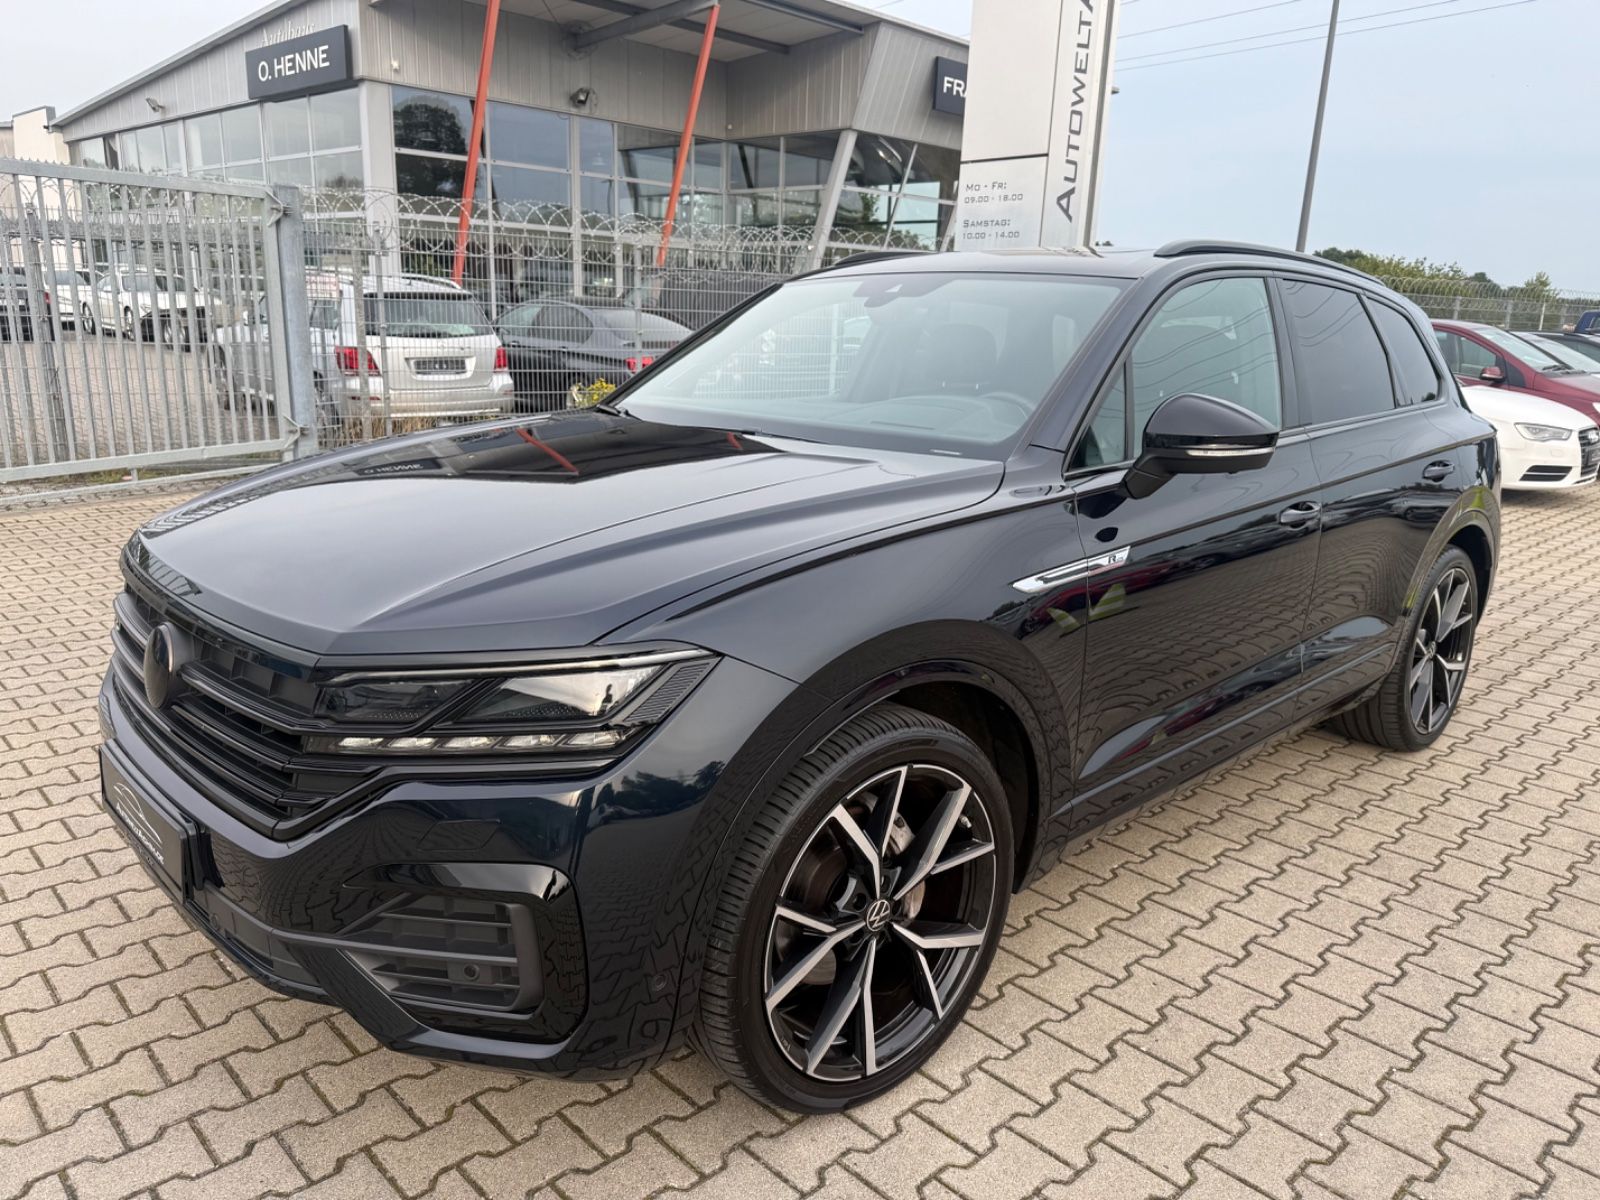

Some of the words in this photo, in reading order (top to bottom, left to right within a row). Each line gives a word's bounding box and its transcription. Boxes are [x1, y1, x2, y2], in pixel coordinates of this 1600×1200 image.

[258, 60, 272, 83] O.
[274, 45, 330, 79] HENNE
[943, 75, 968, 98] FR
[964, 195, 989, 204] 09.00
[962, 219, 1011, 228] SAMSTAG:
[963, 232, 986, 240] 10.00
[995, 231, 1020, 239] 14.00
